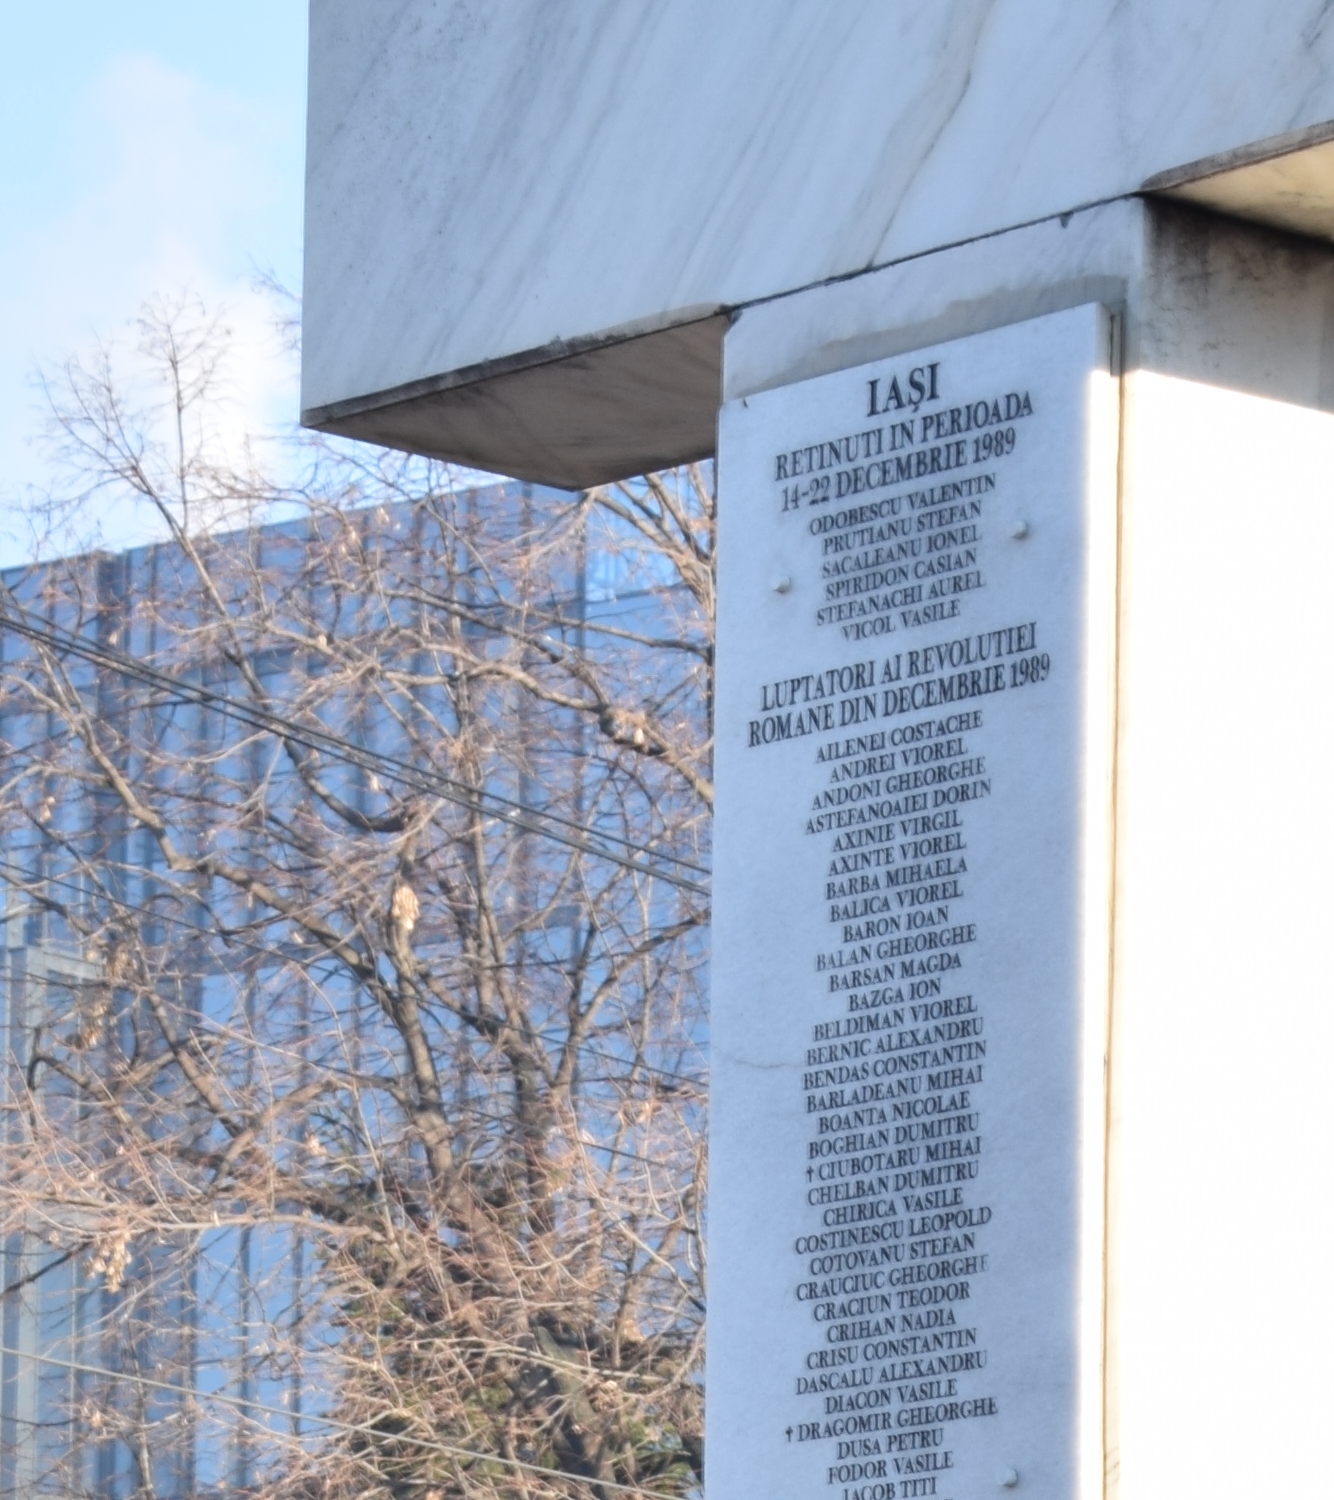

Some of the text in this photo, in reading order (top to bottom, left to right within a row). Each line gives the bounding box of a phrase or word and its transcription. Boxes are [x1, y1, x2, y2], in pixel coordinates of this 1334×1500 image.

[775, 391, 1033, 481] RETINUTI IN PERIOADA
[781, 428, 1016, 512] 14-22 DECEMBRIE 1989
[810, 473, 996, 535] ODOBESCU VALENTIN
[823, 501, 982, 555] PRUTIANU STEFAN
[822, 525, 982, 578] SACALEANU IONEL
[826, 549, 977, 600] SPIRIDON CASIAN
[816, 570, 986, 625] STEFANACHI AUREL
[841, 600, 960, 642] VICOL VASILE
[762, 623, 1037, 712] LUPTATORI AI REVOLUTIEI
[748, 653, 1050, 748] ROMANE DIN DECEMBRIE 1989
[816, 710, 983, 763] AILENEI COSTACHE
[830, 738, 968, 783] ANDREI VIOREL
[806, 778, 991, 835] ASTEFANOAIEI DORIN
[812, 757, 986, 811] ANDONI GHEORGHE
[899, 833, 966, 860] VIOREL
[826, 856, 968, 900] BARBA MIHAELA
[830, 880, 963, 922] BALICA VIOREL
[843, 905, 949, 943] BARON IOAN
[817, 924, 976, 972] BALAN GHEORGHE
[830, 952, 962, 992] BARSAN MAGDA
[849, 978, 940, 1012] BAZGA ION
[814, 996, 977, 1041] BELDIMAN VIOREL
[807, 1017, 983, 1066] BERNIC ALEXANDRU
[807, 1065, 983, 1113] BARLADEANU MIHAI
[819, 1091, 970, 1134] BOANTA NICOLAE
[809, 1113, 979, 1160] BOGHIAN DUMITRU
[819, 1136, 981, 1181] CIUBOTARU MIHAI
[808, 1160, 979, 1206] CHELBAN DUMITRU
[823, 1187, 963, 1226] CHIRICA VASILE
[795, 1206, 992, 1254] COSTINESCU LEOPOLD
[810, 1233, 975, 1275] COTOVANU STEFAN
[814, 1281, 970, 1321] CRACIUN TEODOR
[827, 1308, 956, 1343] CRIHAN NADIA
[807, 1328, 976, 1369] CRISU CONSTANTIN
[825, 1379, 957, 1414] DIACON VASILE
[798, 1397, 998, 1442] DRAGOMIR GHEORGHE
[837, 1428, 943, 1459] DUSA PETRU
[828, 1451, 954, 1485] FODOR VASILE
[900, 1477, 936, 1498] TITI
